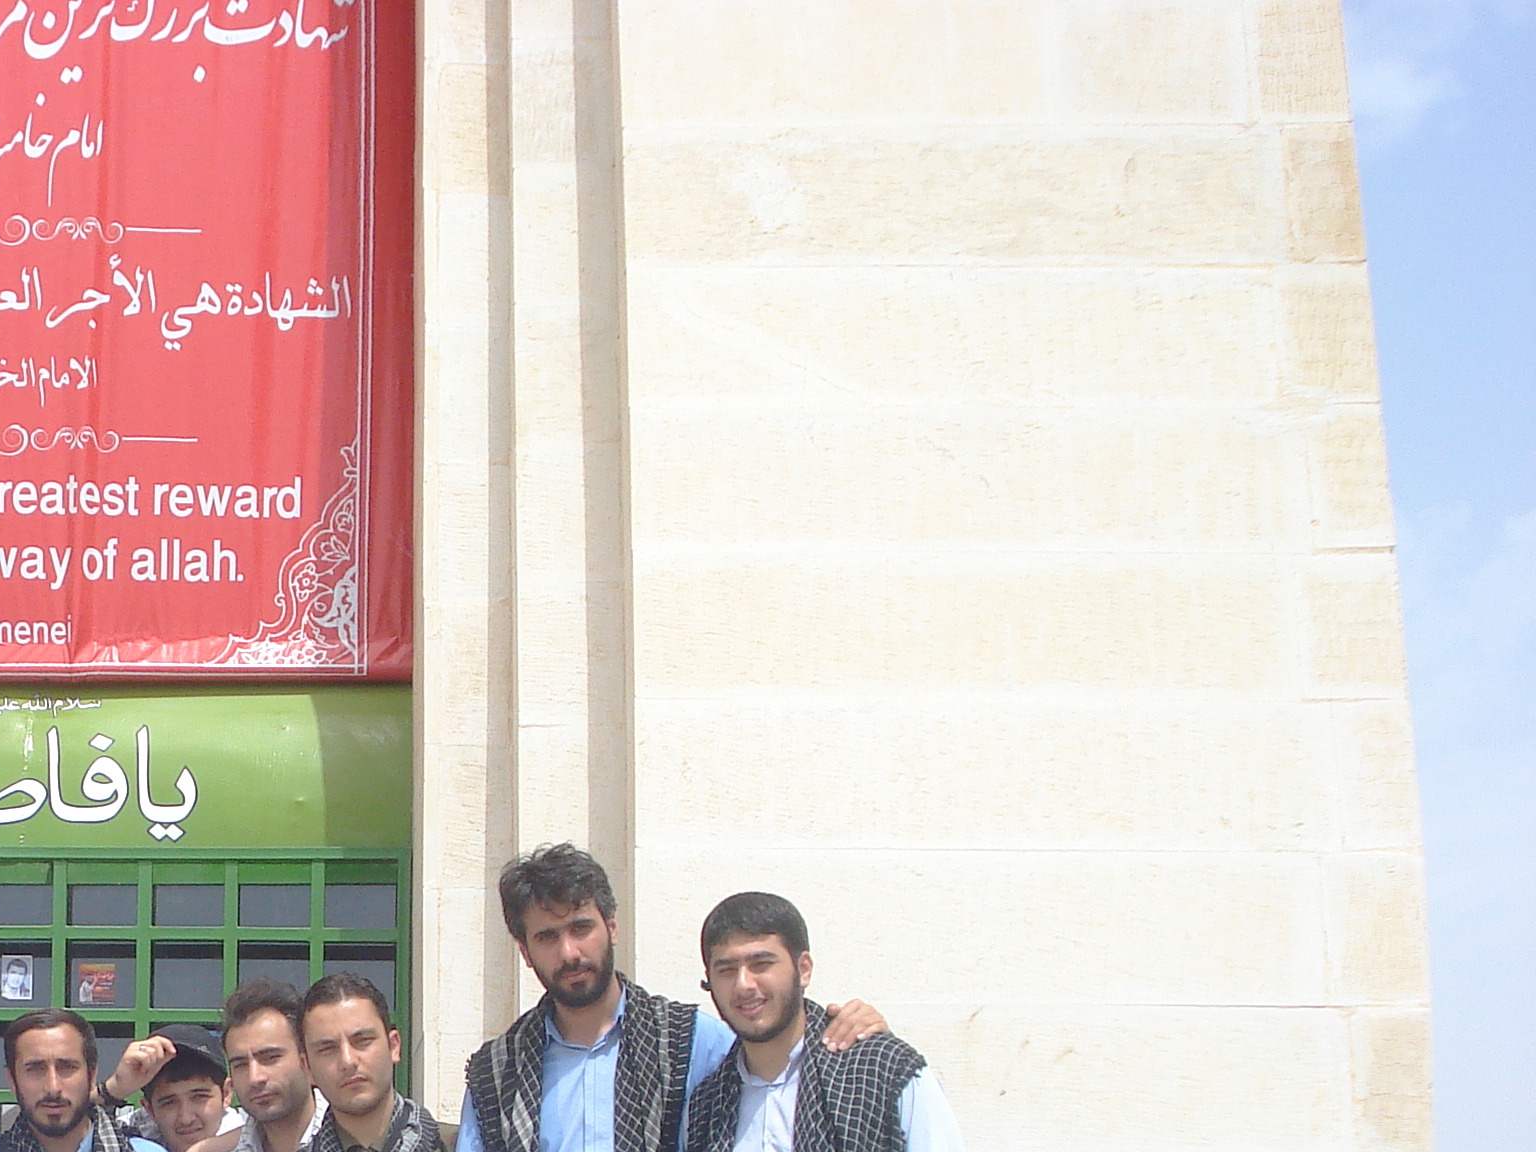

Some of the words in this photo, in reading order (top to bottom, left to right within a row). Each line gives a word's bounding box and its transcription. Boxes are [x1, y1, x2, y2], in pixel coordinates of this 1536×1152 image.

[48, 114, 104, 207] امام
[226, 272, 352, 332] الشهادة
[153, 476, 302, 519] reward
[82, 537, 119, 581] of
[130, 538, 245, 582] allah.
